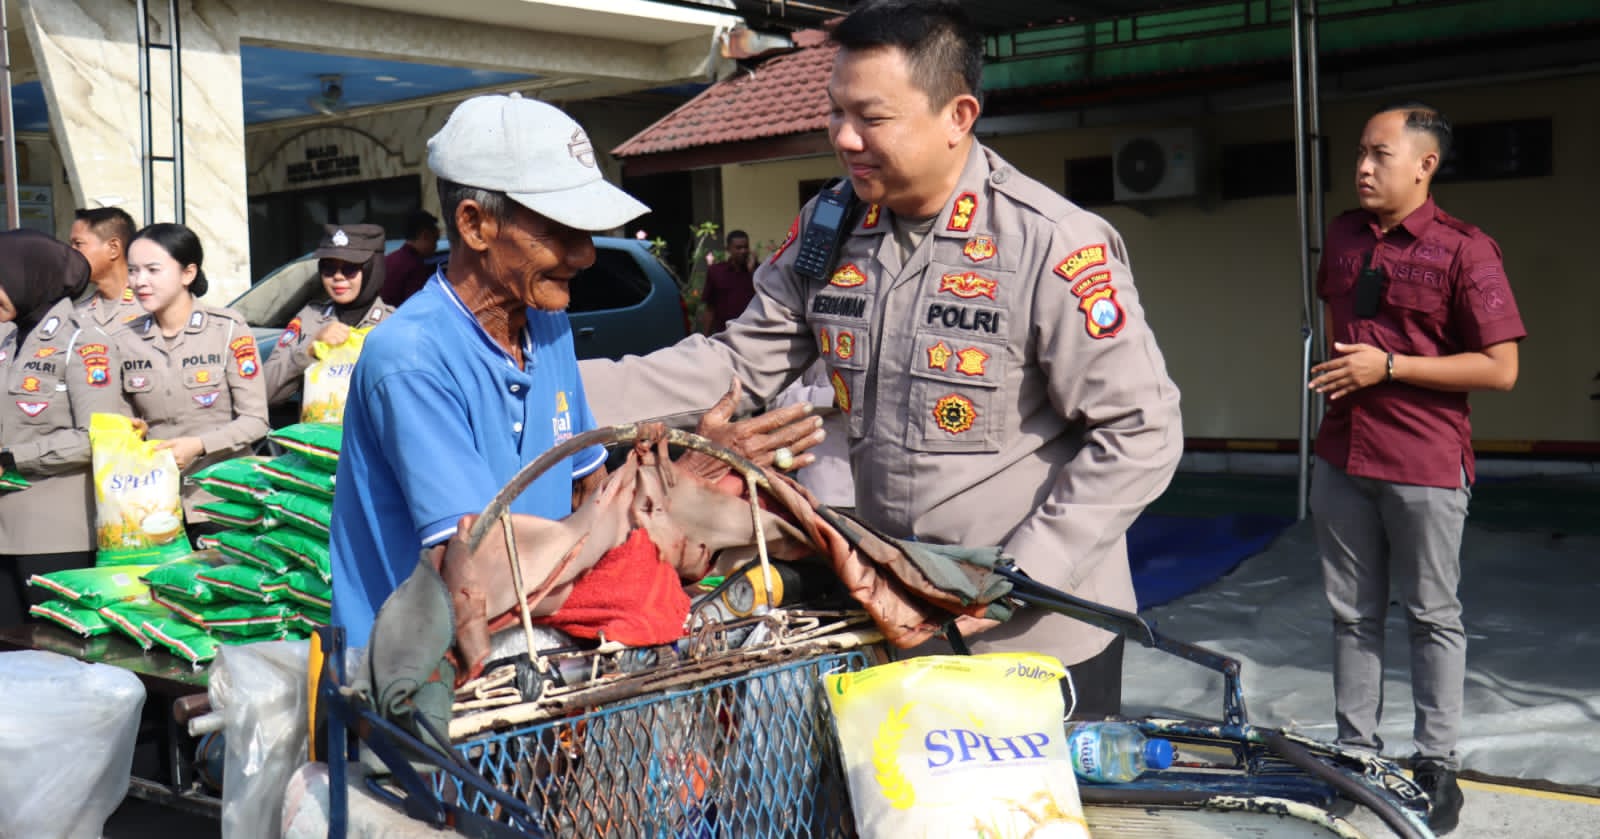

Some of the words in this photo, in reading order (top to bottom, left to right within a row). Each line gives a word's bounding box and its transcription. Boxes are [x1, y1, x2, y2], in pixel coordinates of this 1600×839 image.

[927, 303, 1000, 334] POLRI
[123, 359, 153, 371] DITA
[182, 353, 221, 368] POLRI
[924, 728, 1050, 769] SPHP
[1080, 736, 1097, 774] AQUA
